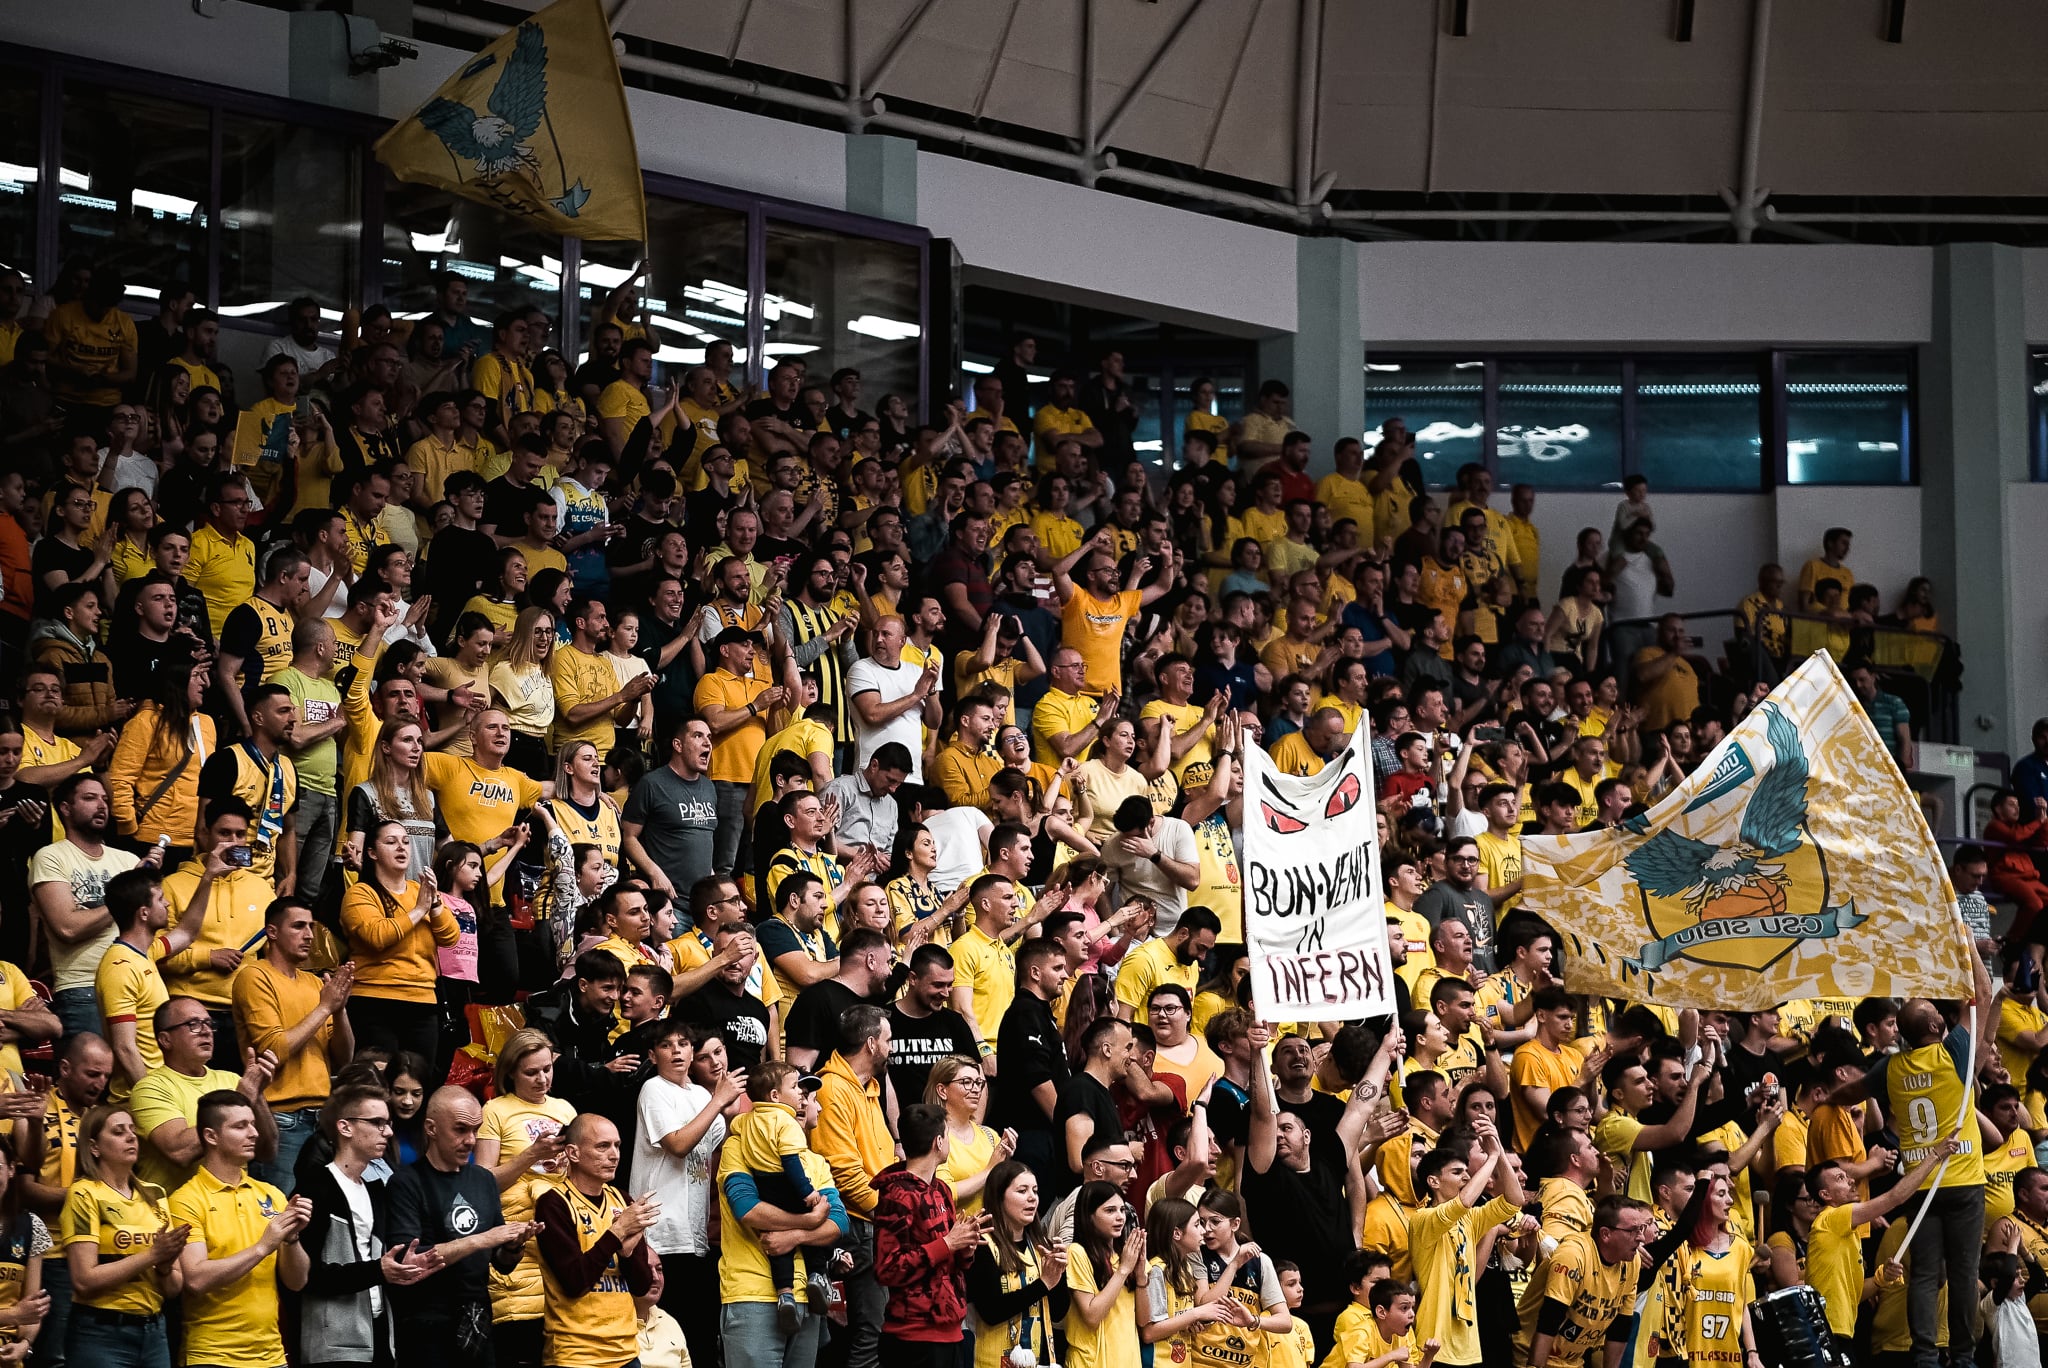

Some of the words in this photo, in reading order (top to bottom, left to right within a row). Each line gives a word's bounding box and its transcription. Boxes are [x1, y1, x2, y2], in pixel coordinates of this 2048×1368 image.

[266, 617, 278, 636] 8
[469, 781, 514, 803] PUMA
[678, 801, 716, 818] PARIS
[1296, 915, 1325, 954] IN
[1265, 948, 1386, 1004] INFERN
[888, 1038, 954, 1054] ULTRAS
[1908, 1097, 1938, 1144] 9
[1702, 1314, 1730, 1340] 97
